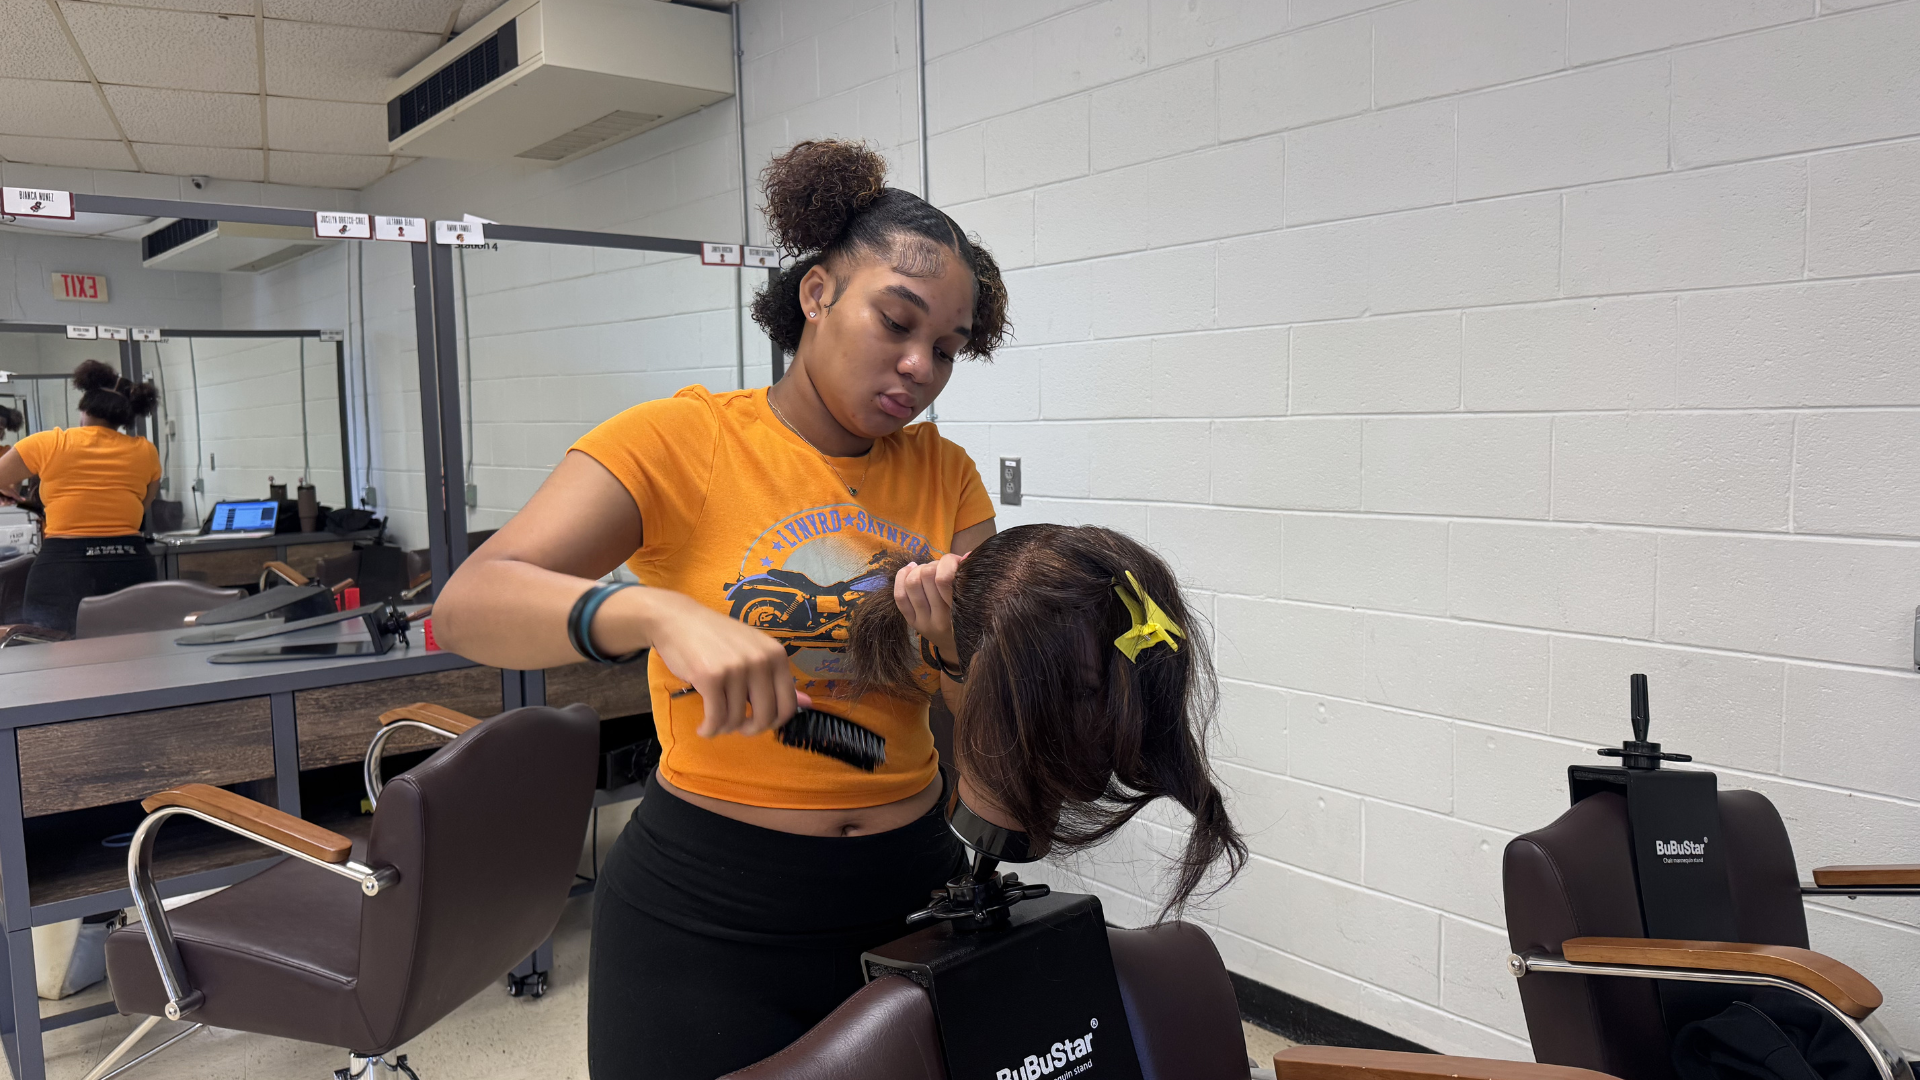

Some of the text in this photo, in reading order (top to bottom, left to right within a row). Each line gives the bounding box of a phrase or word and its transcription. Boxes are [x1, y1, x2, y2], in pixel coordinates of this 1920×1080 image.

[19, 190, 54, 202] BIANCA NUNEZ
[492, 242, 498, 252] 4
[776, 510, 842, 548] LYNYRD
[1073, 1058, 1094, 1077] stand
